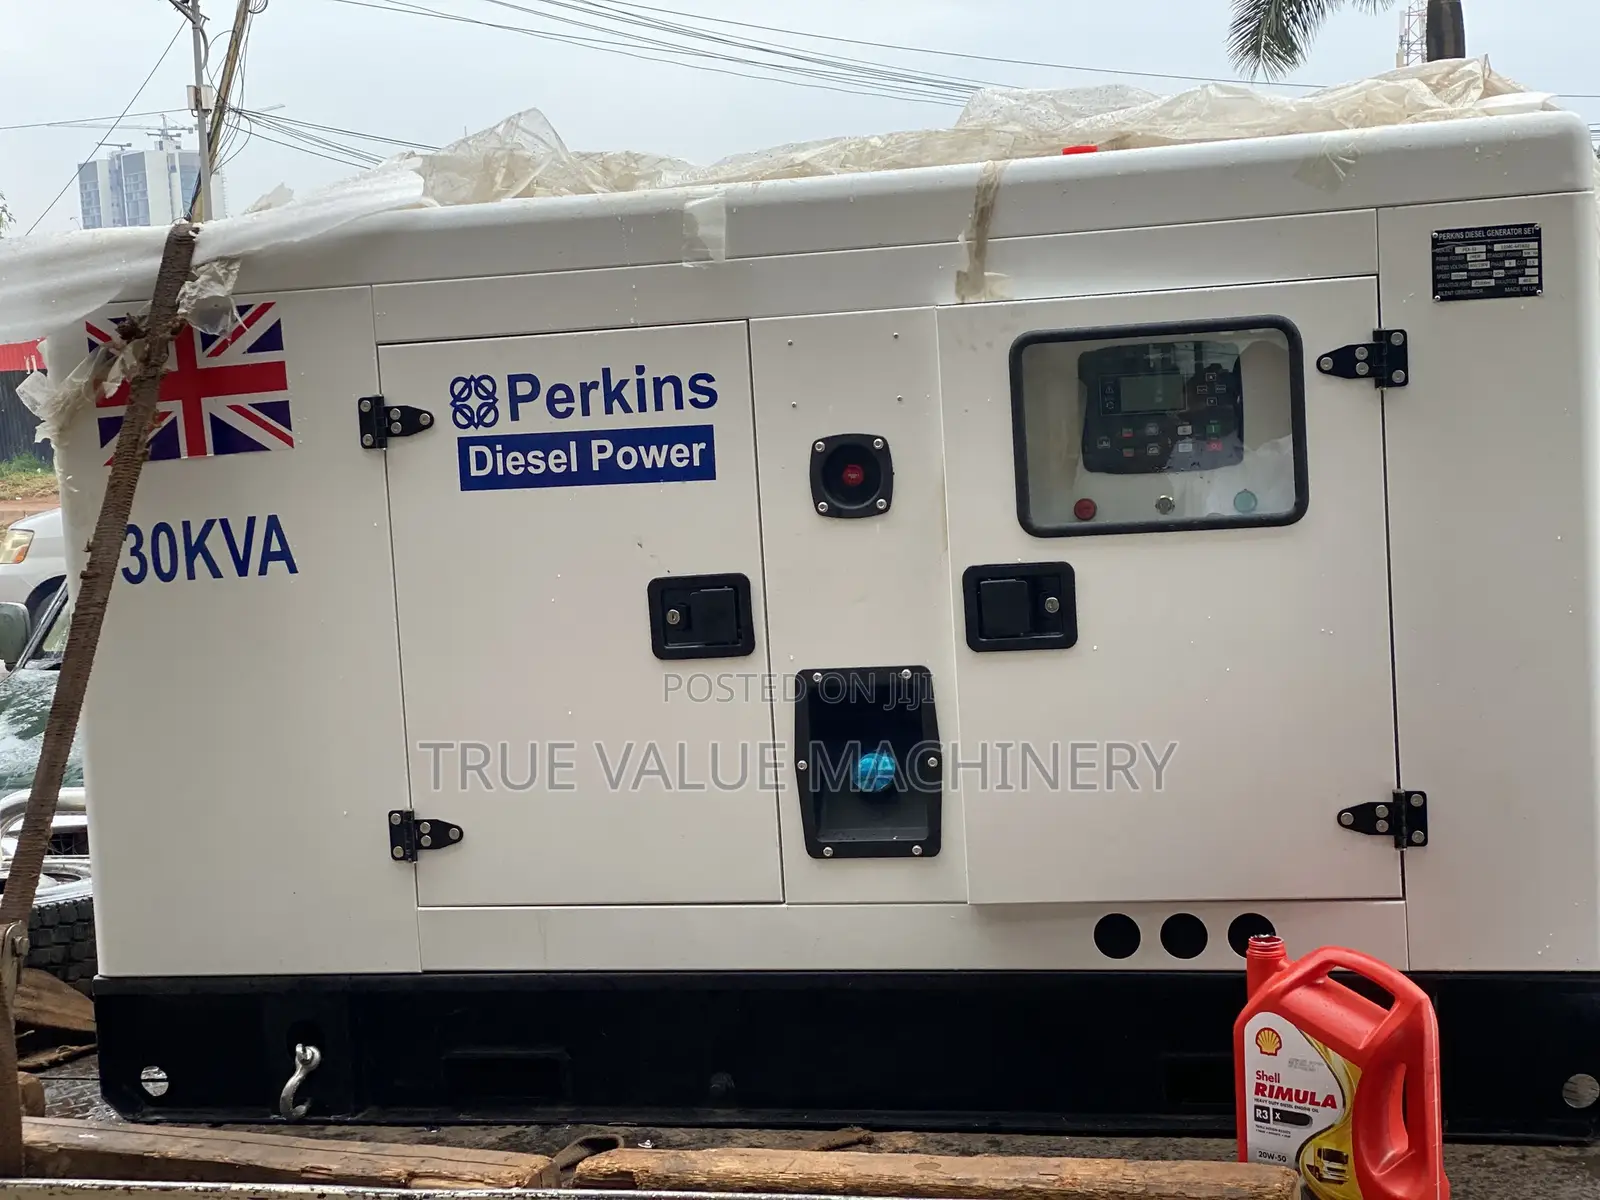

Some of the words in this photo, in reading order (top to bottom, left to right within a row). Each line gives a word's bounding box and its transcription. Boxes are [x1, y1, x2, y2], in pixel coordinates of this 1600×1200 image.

[1439, 232, 1464, 240] PERKINS
[1465, 230, 1485, 239] DIESEL
[1487, 228, 1523, 237] GENERATOR
[1523, 227, 1535, 235] SET
[507, 365, 718, 421] Perkins
[469, 441, 578, 477] Diesel
[591, 439, 706, 471] Power
[122, 515, 299, 584] 30KVA
[1256, 1070, 1280, 1083] Shell
[1254, 1082, 1337, 1109] RIMULA
[1256, 1109, 1268, 1120] R3
[1274, 1112, 1281, 1120] X
[1258, 1150, 1287, 1163] 20W-50
